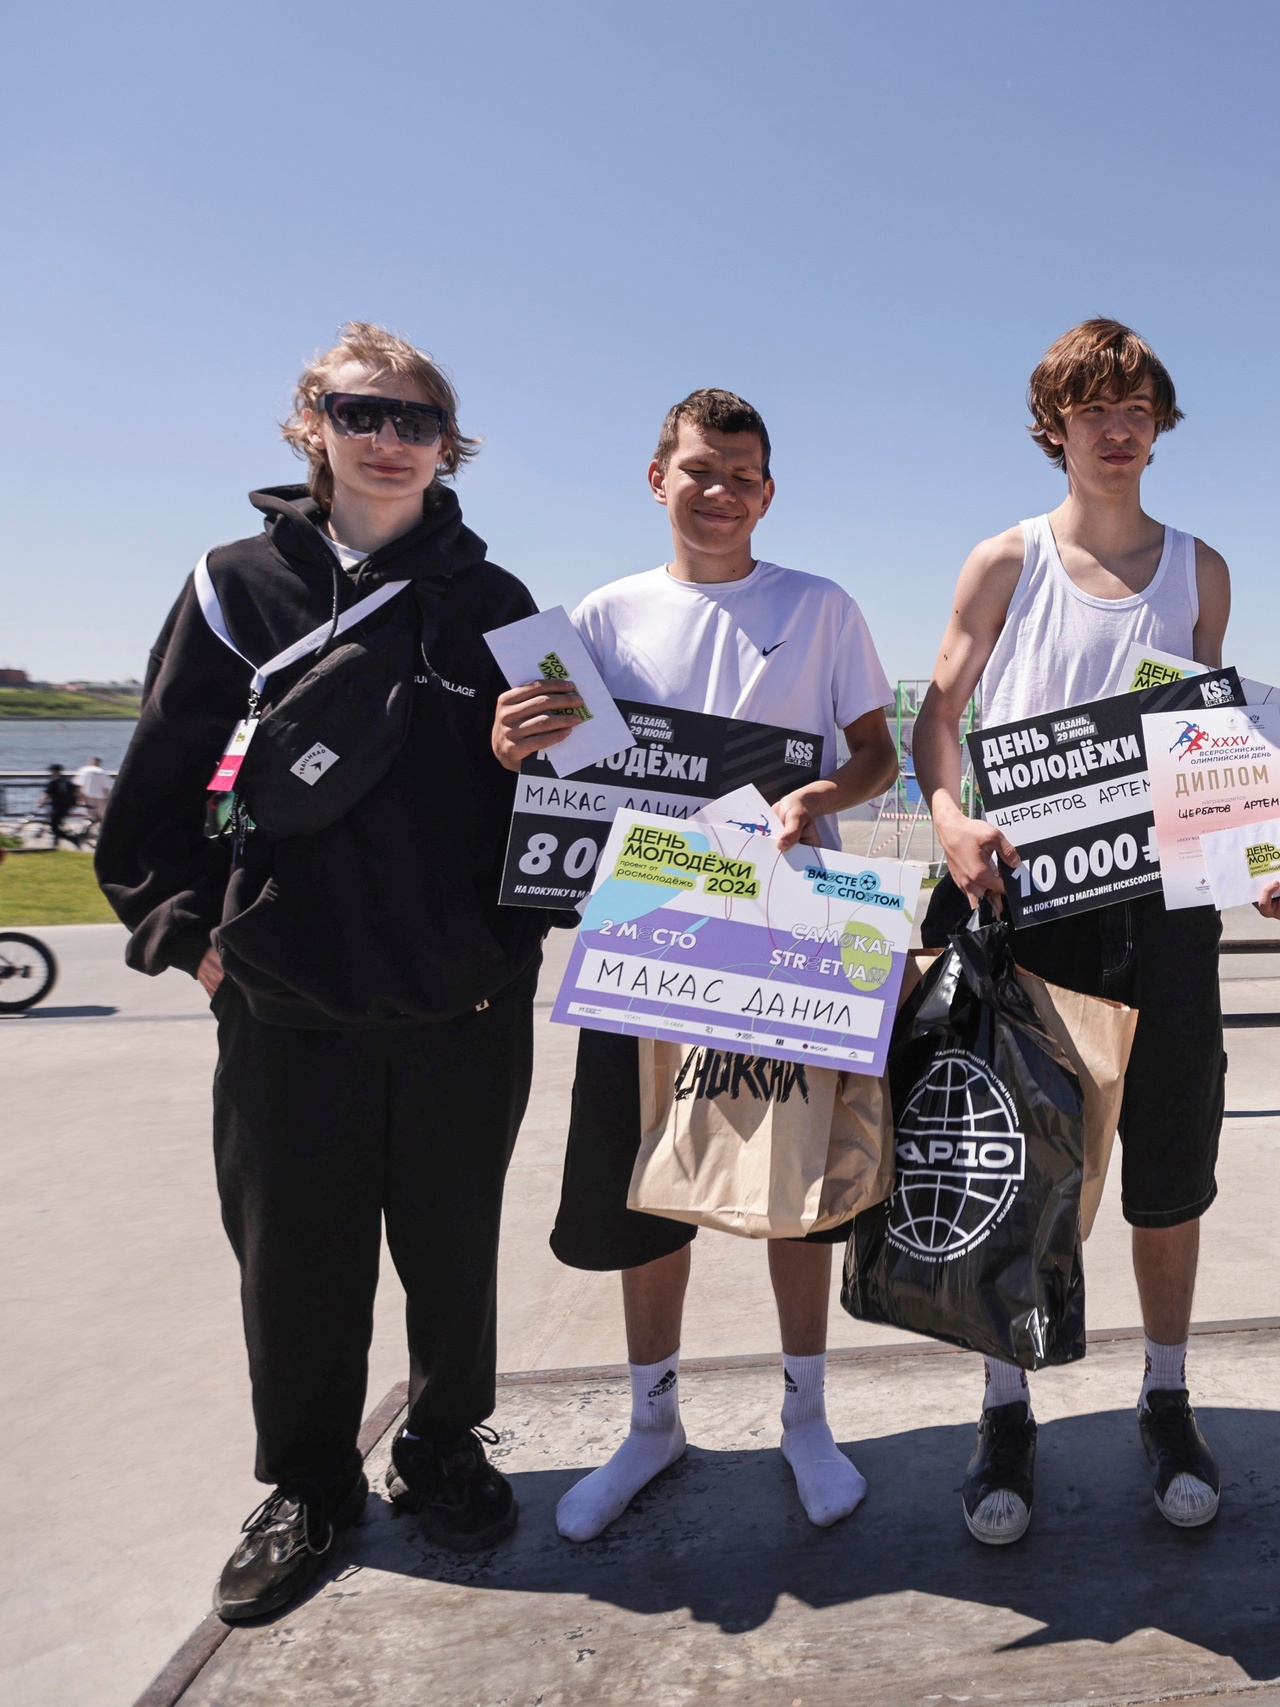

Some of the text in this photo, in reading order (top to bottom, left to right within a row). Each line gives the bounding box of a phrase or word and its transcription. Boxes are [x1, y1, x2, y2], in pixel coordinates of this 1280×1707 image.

[441, 679, 475, 698] VILLAGE
[1200, 678, 1233, 701] KSS
[630, 715, 670, 730] КАЗАНЬ,
[1054, 717, 1090, 733] КАЗАНЬ,
[642, 728, 673, 740] ИЮНЯ
[1056, 725, 1095, 743] 29 ИЮНЯ
[1211, 736, 1250, 749] XXXV
[785, 739, 814, 761] KSS
[981, 727, 1050, 768] ДЕНЬ
[1190, 751, 1272, 765] ОЛИМПИЙСКИЙ ДЕНЬ
[1199, 745, 1266, 757] ВСЕРОССИЙСКИЙ
[299, 749, 326, 774] TRAILHEAD
[987, 734, 1142, 795] МОЛОДЁЖИ
[1175, 765, 1270, 798] ДИПЛОМ
[525, 785, 607, 811] МАКАС
[1244, 798, 1280, 810] АРТЕМ
[995, 793, 1087, 827] ЩЕРБАТОВ
[627, 827, 686, 850] ДЕНЬ
[624, 843, 753, 879] МОЛОДЁЖИ
[1246, 845, 1275, 857] ДЕНЬ
[619, 860, 647, 870] проект
[616, 868, 694, 888] росмолодёжь
[707, 877, 757, 896] 2024
[807, 869, 858, 887] ВМЕСТЕ
[514, 885, 527, 894] НА
[527, 886, 570, 897] ПОКУПКУ
[817, 883, 901, 908] СО СПОРТОМ
[1023, 904, 1033, 915] НА
[1034, 894, 1068, 913] ПОКУПКУ
[1069, 892, 1075, 902] В
[1075, 882, 1113, 901] МАГАЗИНЕ
[598, 919, 697, 950] 2 МЕСТО
[791, 923, 895, 956] САМОКАТ
[769, 949, 843, 976] STREET
[597, 958, 851, 1027] МАКАС ДАНИЛ
